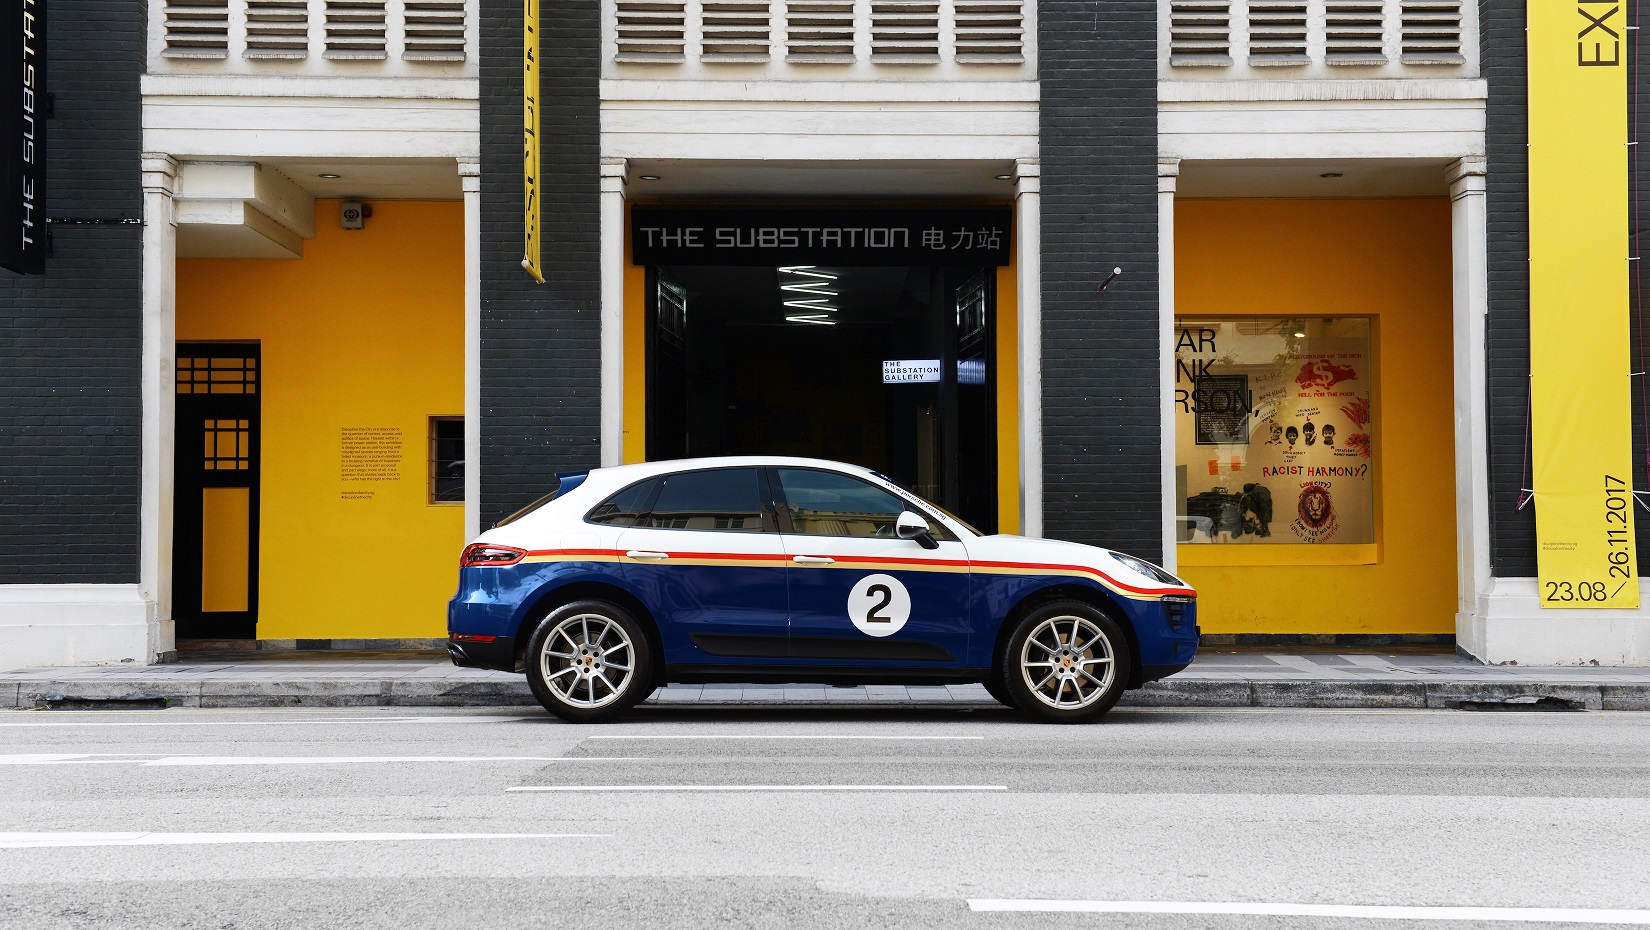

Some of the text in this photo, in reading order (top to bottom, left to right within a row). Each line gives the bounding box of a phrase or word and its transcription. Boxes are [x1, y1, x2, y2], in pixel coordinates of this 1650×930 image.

[22, 175, 34, 250] THE
[640, 228, 909, 248] THE SUBSTATION
[922, 226, 1003, 250] 电力站
[1262, 464, 1368, 480] RACIST HARMONY?
[885, 482, 946, 520] www.porsche.com.sg
[1604, 474, 1630, 578] 26.11.2017
[866, 584, 892, 623] 2
[1546, 582, 1607, 602] 23.08
